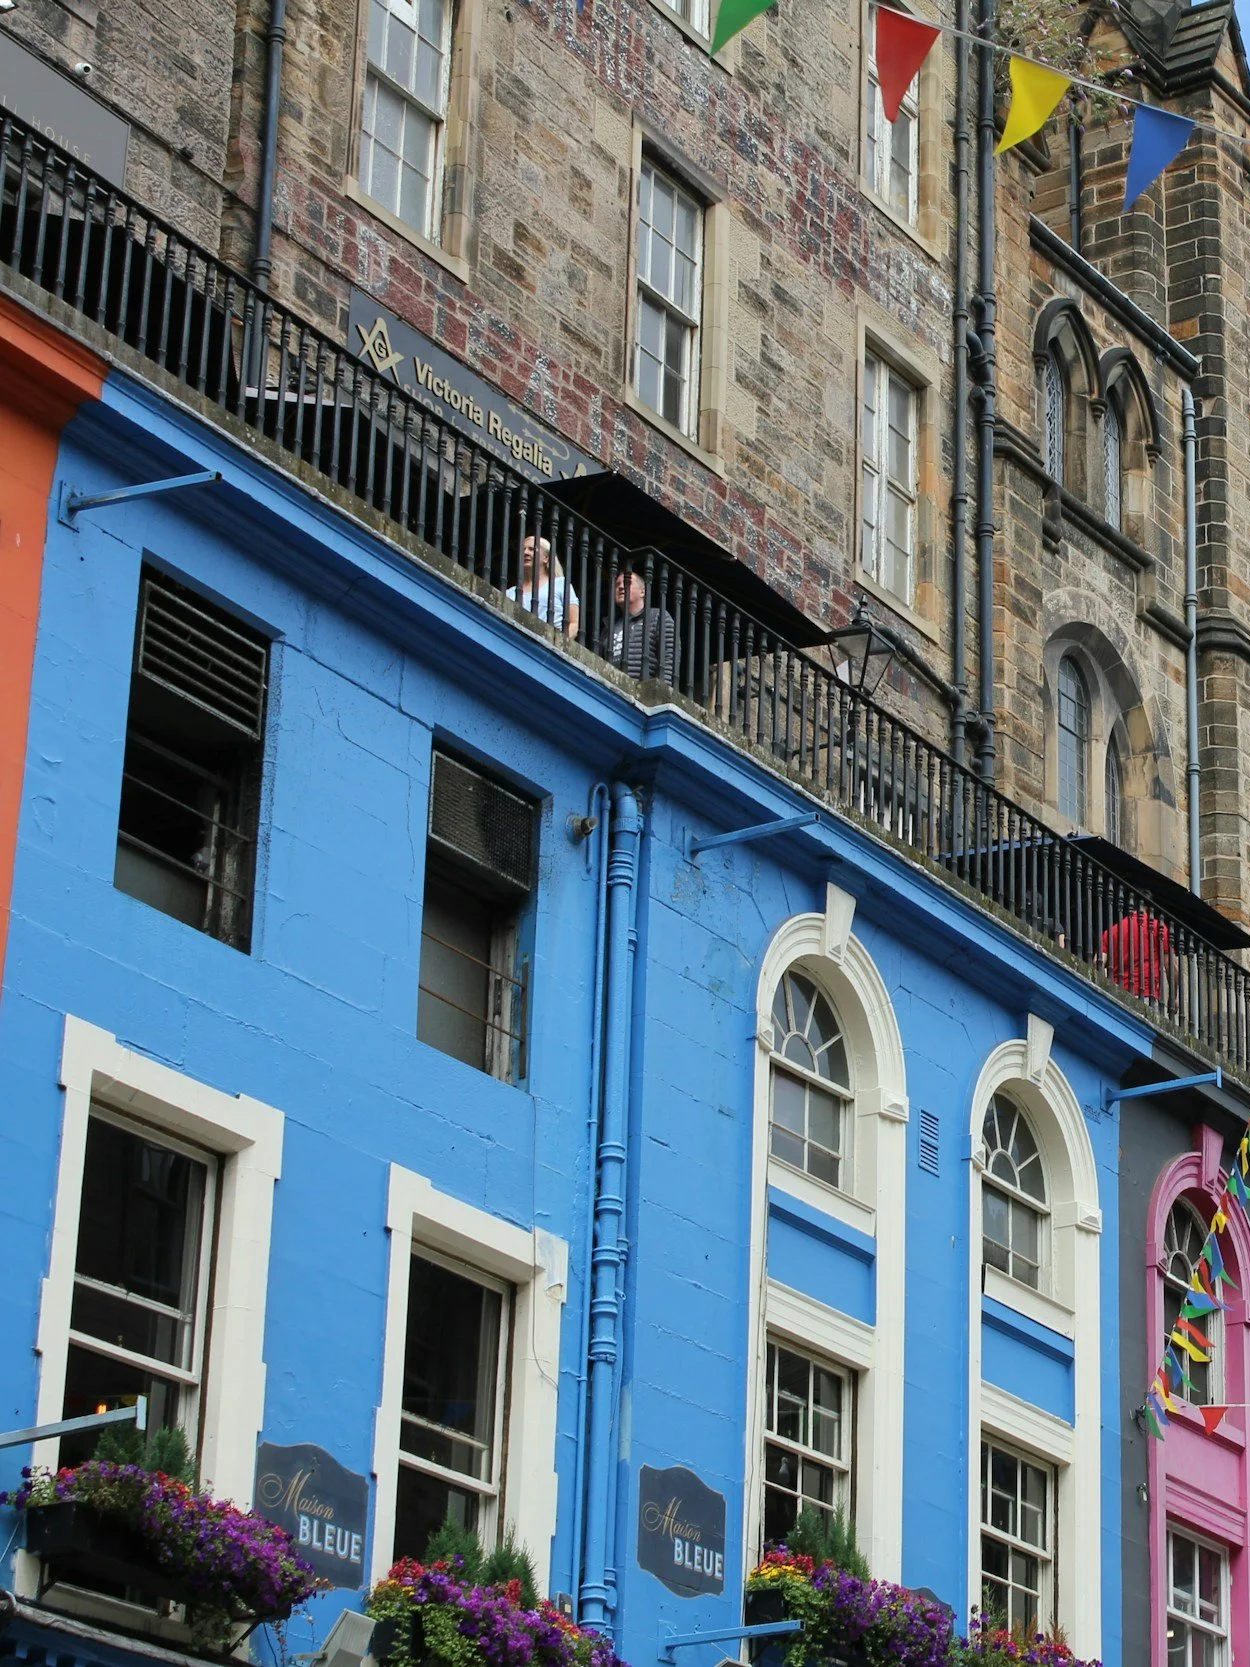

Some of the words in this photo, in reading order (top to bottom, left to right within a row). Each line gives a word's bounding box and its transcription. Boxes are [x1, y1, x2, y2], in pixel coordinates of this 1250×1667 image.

[414, 356, 484, 428] Victoria
[488, 409, 553, 478] Regalia
[258, 1468, 335, 1521] Maison
[641, 1496, 702, 1544] Maison
[298, 1513, 363, 1565] BLEUE
[673, 1536, 724, 1582] BLEUE
